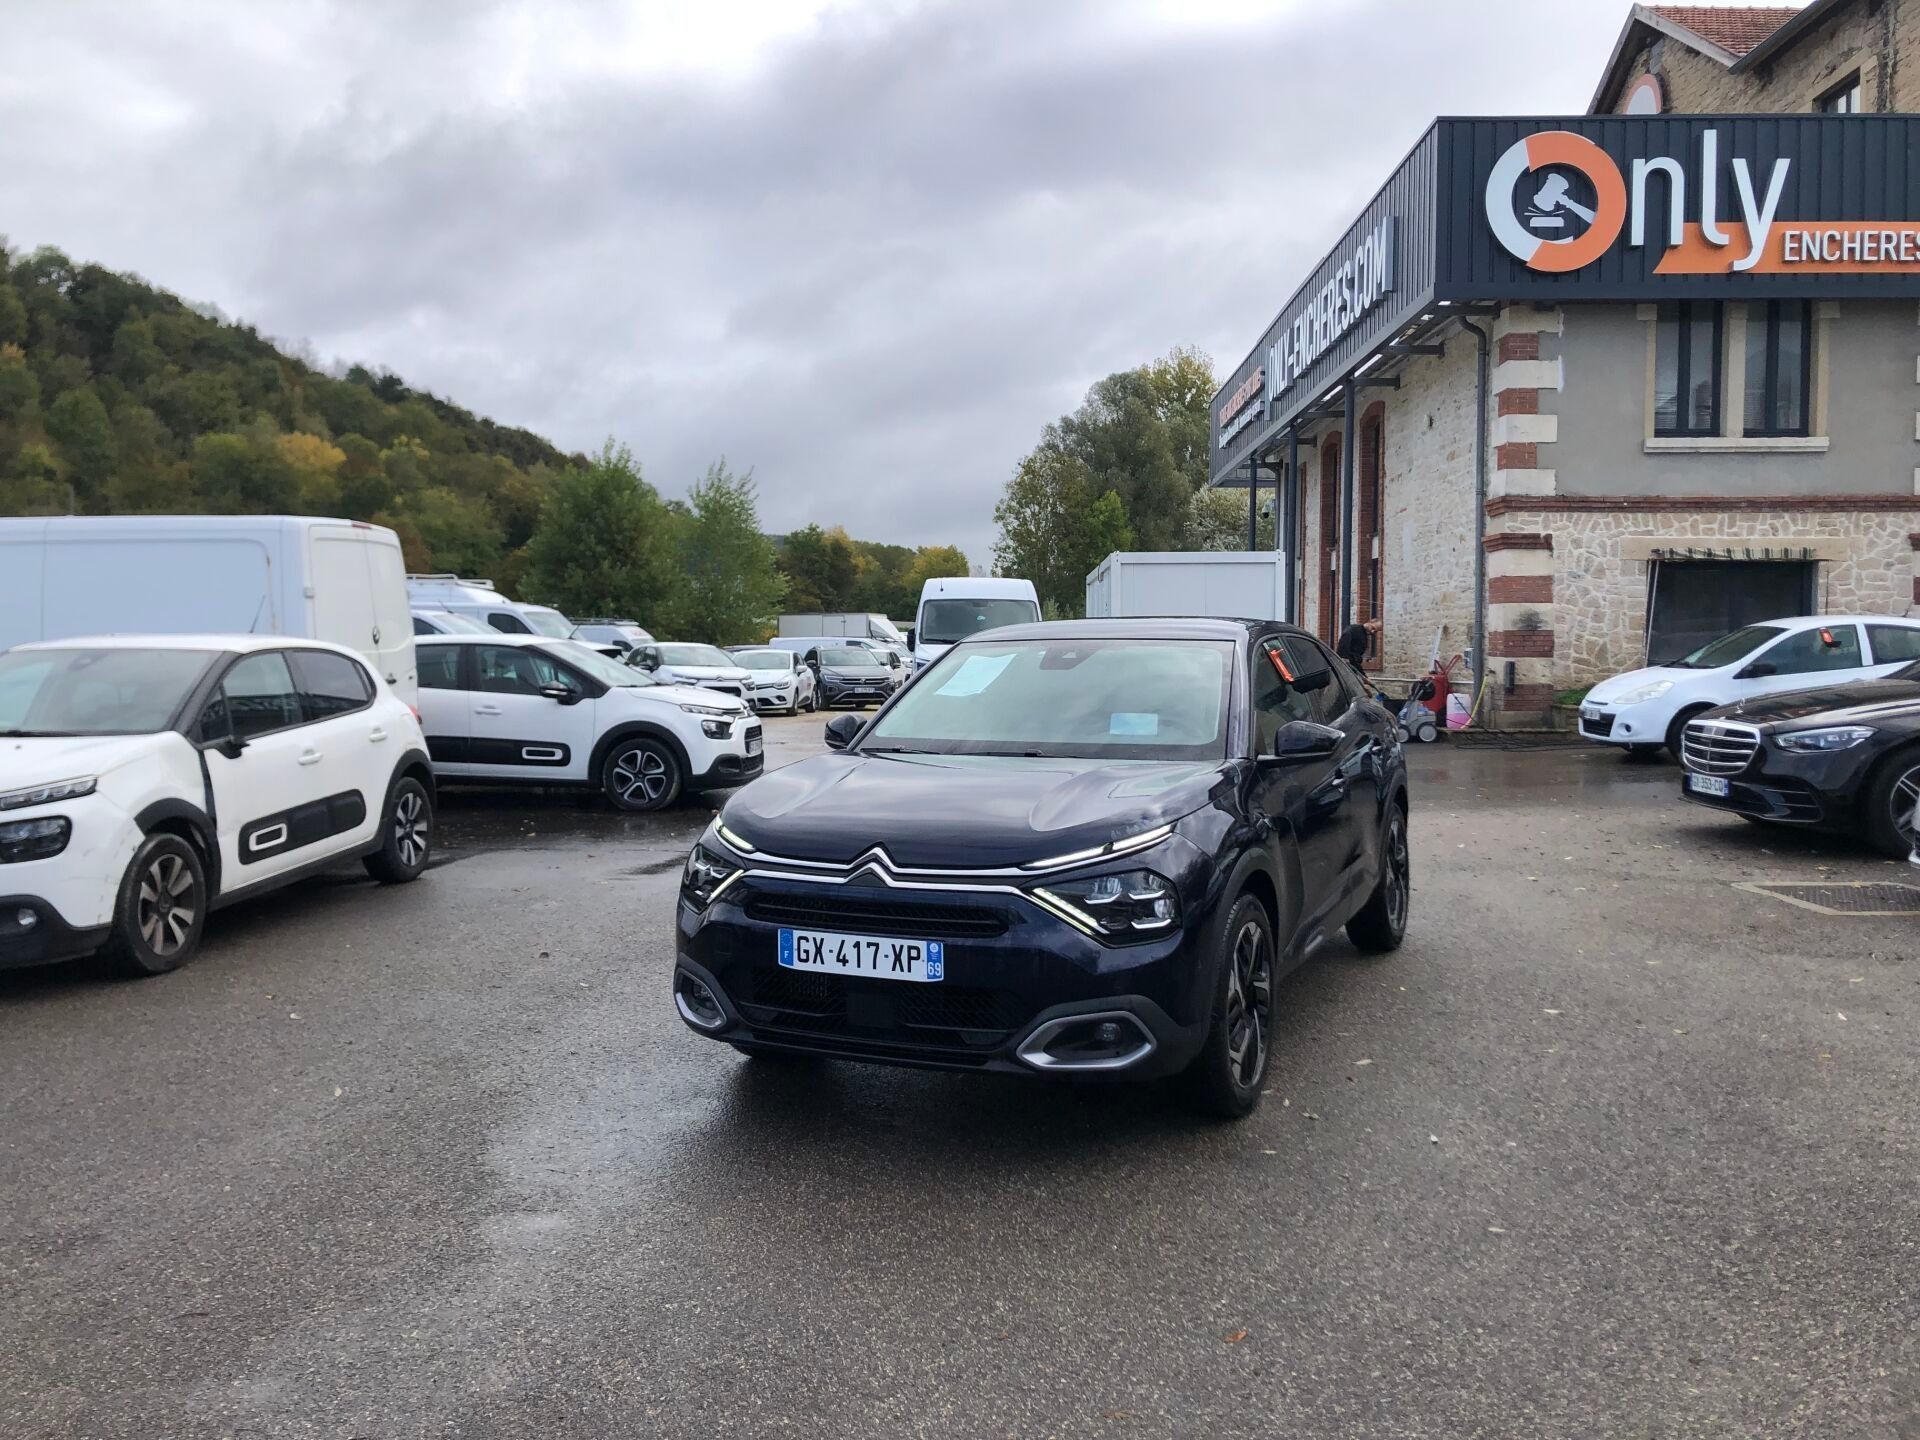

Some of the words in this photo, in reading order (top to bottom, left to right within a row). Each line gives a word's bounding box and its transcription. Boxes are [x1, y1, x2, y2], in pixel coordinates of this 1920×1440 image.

[1485, 129, 1790, 272] Only
[1268, 216, 1388, 401] ONLY-ENCHERES.COM
[796, 935, 921, 973] GX-417-XP
[927, 961, 942, 976] 69
